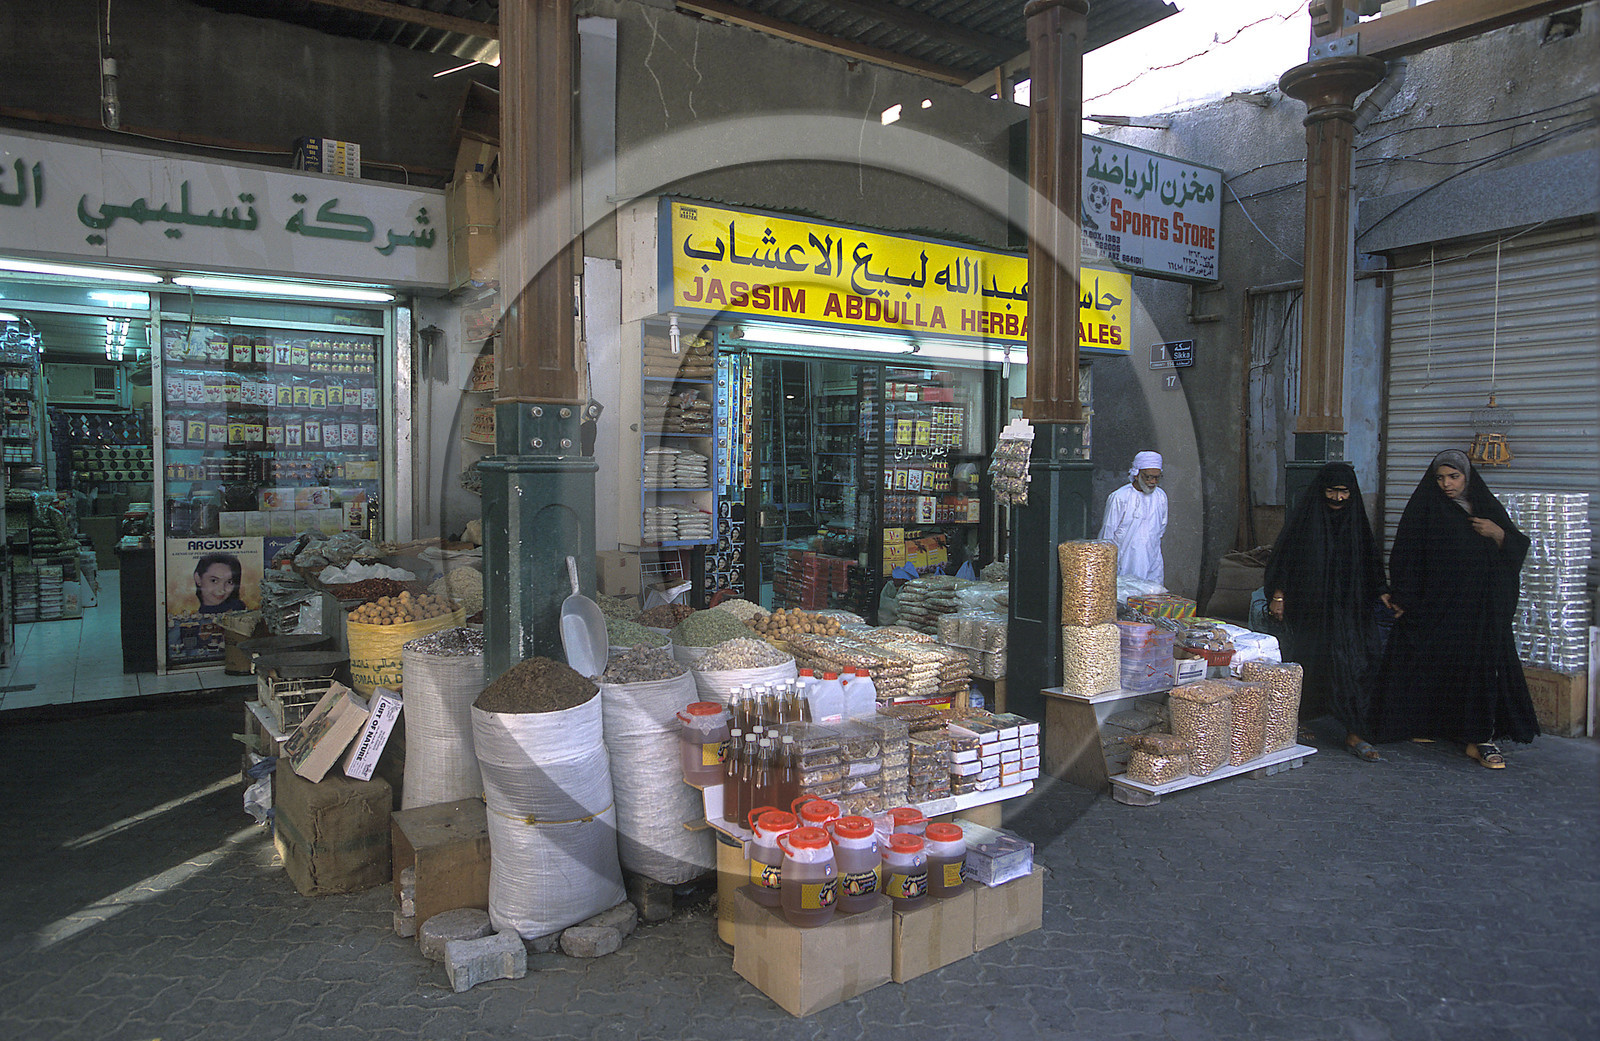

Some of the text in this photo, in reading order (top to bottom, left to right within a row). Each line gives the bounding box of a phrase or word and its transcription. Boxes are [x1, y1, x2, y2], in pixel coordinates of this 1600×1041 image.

[1086, 145, 1215, 209] مخزن الرياضة
[77, 181, 258, 245] تسليمي
[285, 193, 434, 256] شركة
[683, 220, 843, 278] الاعشاب
[851, 242, 928, 300] لبيع
[683, 276, 1122, 346] JASSIM ABDULLA HERBA ALES
[1080, 276, 1123, 321] جاس
[1160, 345, 1190, 360] 1 Sikka
[1166, 375, 1176, 387] 17
[188, 540, 244, 550] ARGUSSY
[370, 720, 379, 731] OF
[376, 702, 386, 719] GIFT
[356, 731, 373, 761] NATURE
